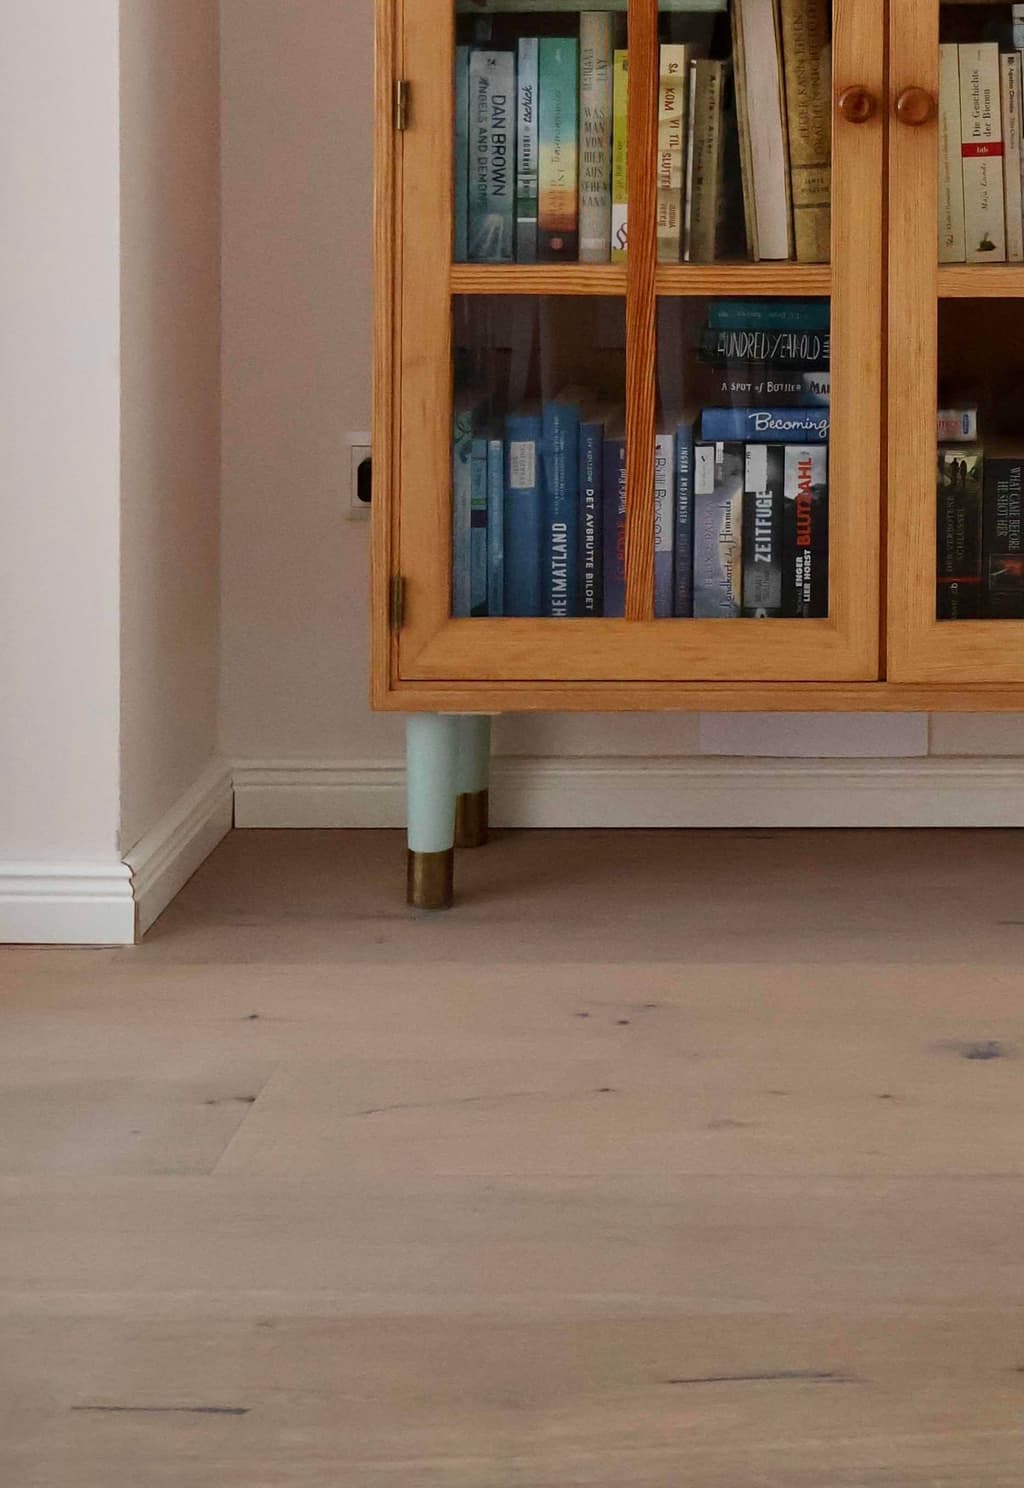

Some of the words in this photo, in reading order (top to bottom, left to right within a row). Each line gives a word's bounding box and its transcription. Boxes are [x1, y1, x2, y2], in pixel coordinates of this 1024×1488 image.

[477, 77, 489, 123] ANGELS
[491, 95, 506, 129] DAN
[664, 88, 675, 111] KOM
[982, 88, 991, 119] Bienen
[669, 119, 680, 129] VI
[972, 123, 981, 137] Die
[982, 123, 991, 137] der
[477, 127, 489, 153] AND
[669, 134, 680, 149] TIL
[491, 134, 506, 196] BROWN
[721, 382, 727, 391] A
[730, 382, 752, 392] SPOT
[748, 412, 830, 438] Becoming
[655, 457, 667, 485] Bill
[1008, 466, 1021, 492] WHAT
[586, 488, 594, 504] DET
[795, 457, 812, 546] BLUTZAHL
[996, 494, 1007, 516] SHOT
[1008, 493, 1020, 516] CAME
[754, 490, 773, 563] ZEITFUGE
[996, 518, 1007, 537] HER
[1007, 519, 1020, 551] BEFORE
[586, 513, 594, 568] AVBRUTTE
[551, 522, 567, 616] HEIMATLAND
[795, 557, 803, 587] ENGER
[803, 549, 811, 580] HORST
[585, 572, 594, 609] BILDET
[803, 583, 811, 602] LIER
